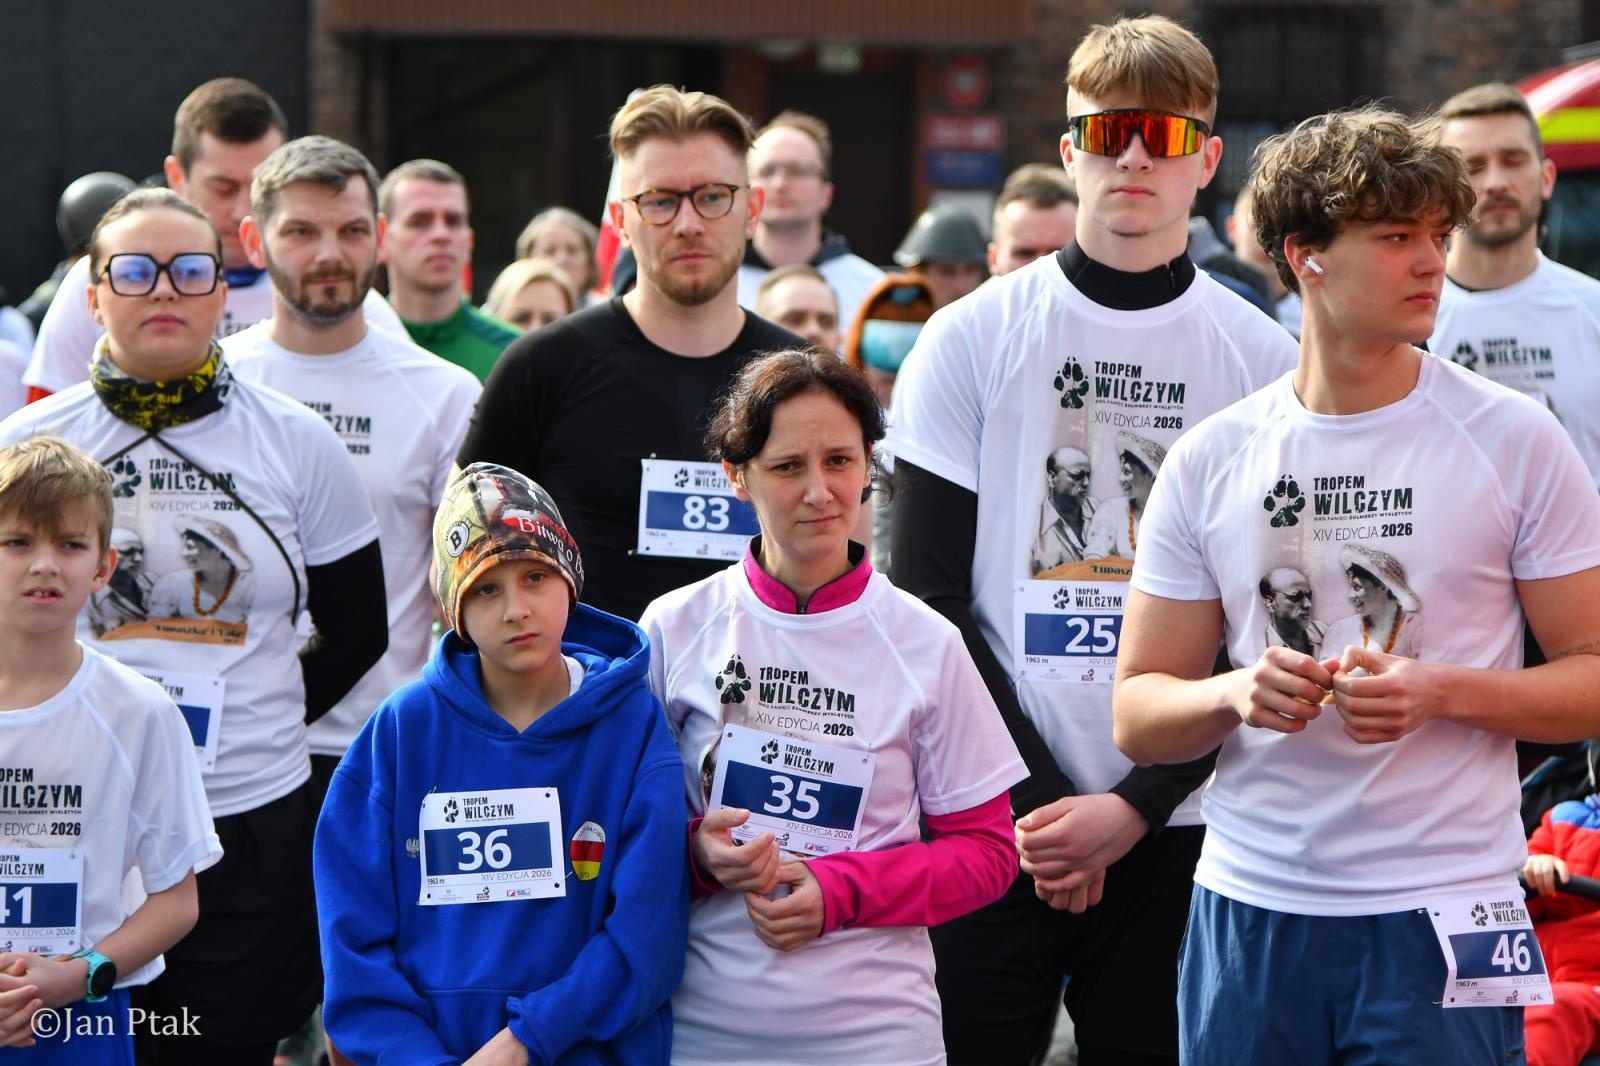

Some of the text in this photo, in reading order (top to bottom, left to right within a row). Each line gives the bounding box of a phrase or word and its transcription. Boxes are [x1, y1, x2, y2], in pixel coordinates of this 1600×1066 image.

[1095, 361, 1142, 378] TROPEM
[1095, 377, 1186, 404] WILCZYM
[1095, 411, 1183, 429] XIV EDYCJA 2026
[694, 477, 731, 489] WILCZY
[1314, 476, 1365, 490] TROPEM
[149, 501, 240, 511] XIV EDYCJA 2026
[1314, 488, 1413, 515] WILCZYM
[682, 495, 730, 532] 83
[517, 517, 564, 552] Bitwa
[1313, 523, 1413, 542] XIV EDYCJA 2026
[1075, 596, 1122, 608] WILCZYM
[1065, 617, 1117, 654] 25
[760, 666, 809, 685] TROPEM
[759, 682, 856, 712] WILCZYM
[755, 711, 854, 737] XIV EDYCJA 2026
[785, 744, 812, 757] TROPEM
[783, 753, 835, 775] WILCZYM
[0, 768, 33, 783] OPEM
[0, 785, 82, 809] ILCZYM
[463, 797, 488, 805] TROPEM
[763, 775, 822, 820] 35
[464, 803, 515, 819] WILCZYM
[4, 821, 81, 836] EDYCJA 2026
[785, 821, 853, 840] XIV EDYCJA 2026
[457, 828, 512, 871] 36
[427, 877, 439, 885] 1963
[481, 873, 495, 882] XIV
[497, 871, 530, 881] EDYCJA
[531, 870, 552, 879] 2026
[1490, 901, 1514, 910] TROPEM
[6, 928, 76, 937] XIV EDYCJA 2026
[1491, 932, 1532, 973] 46
